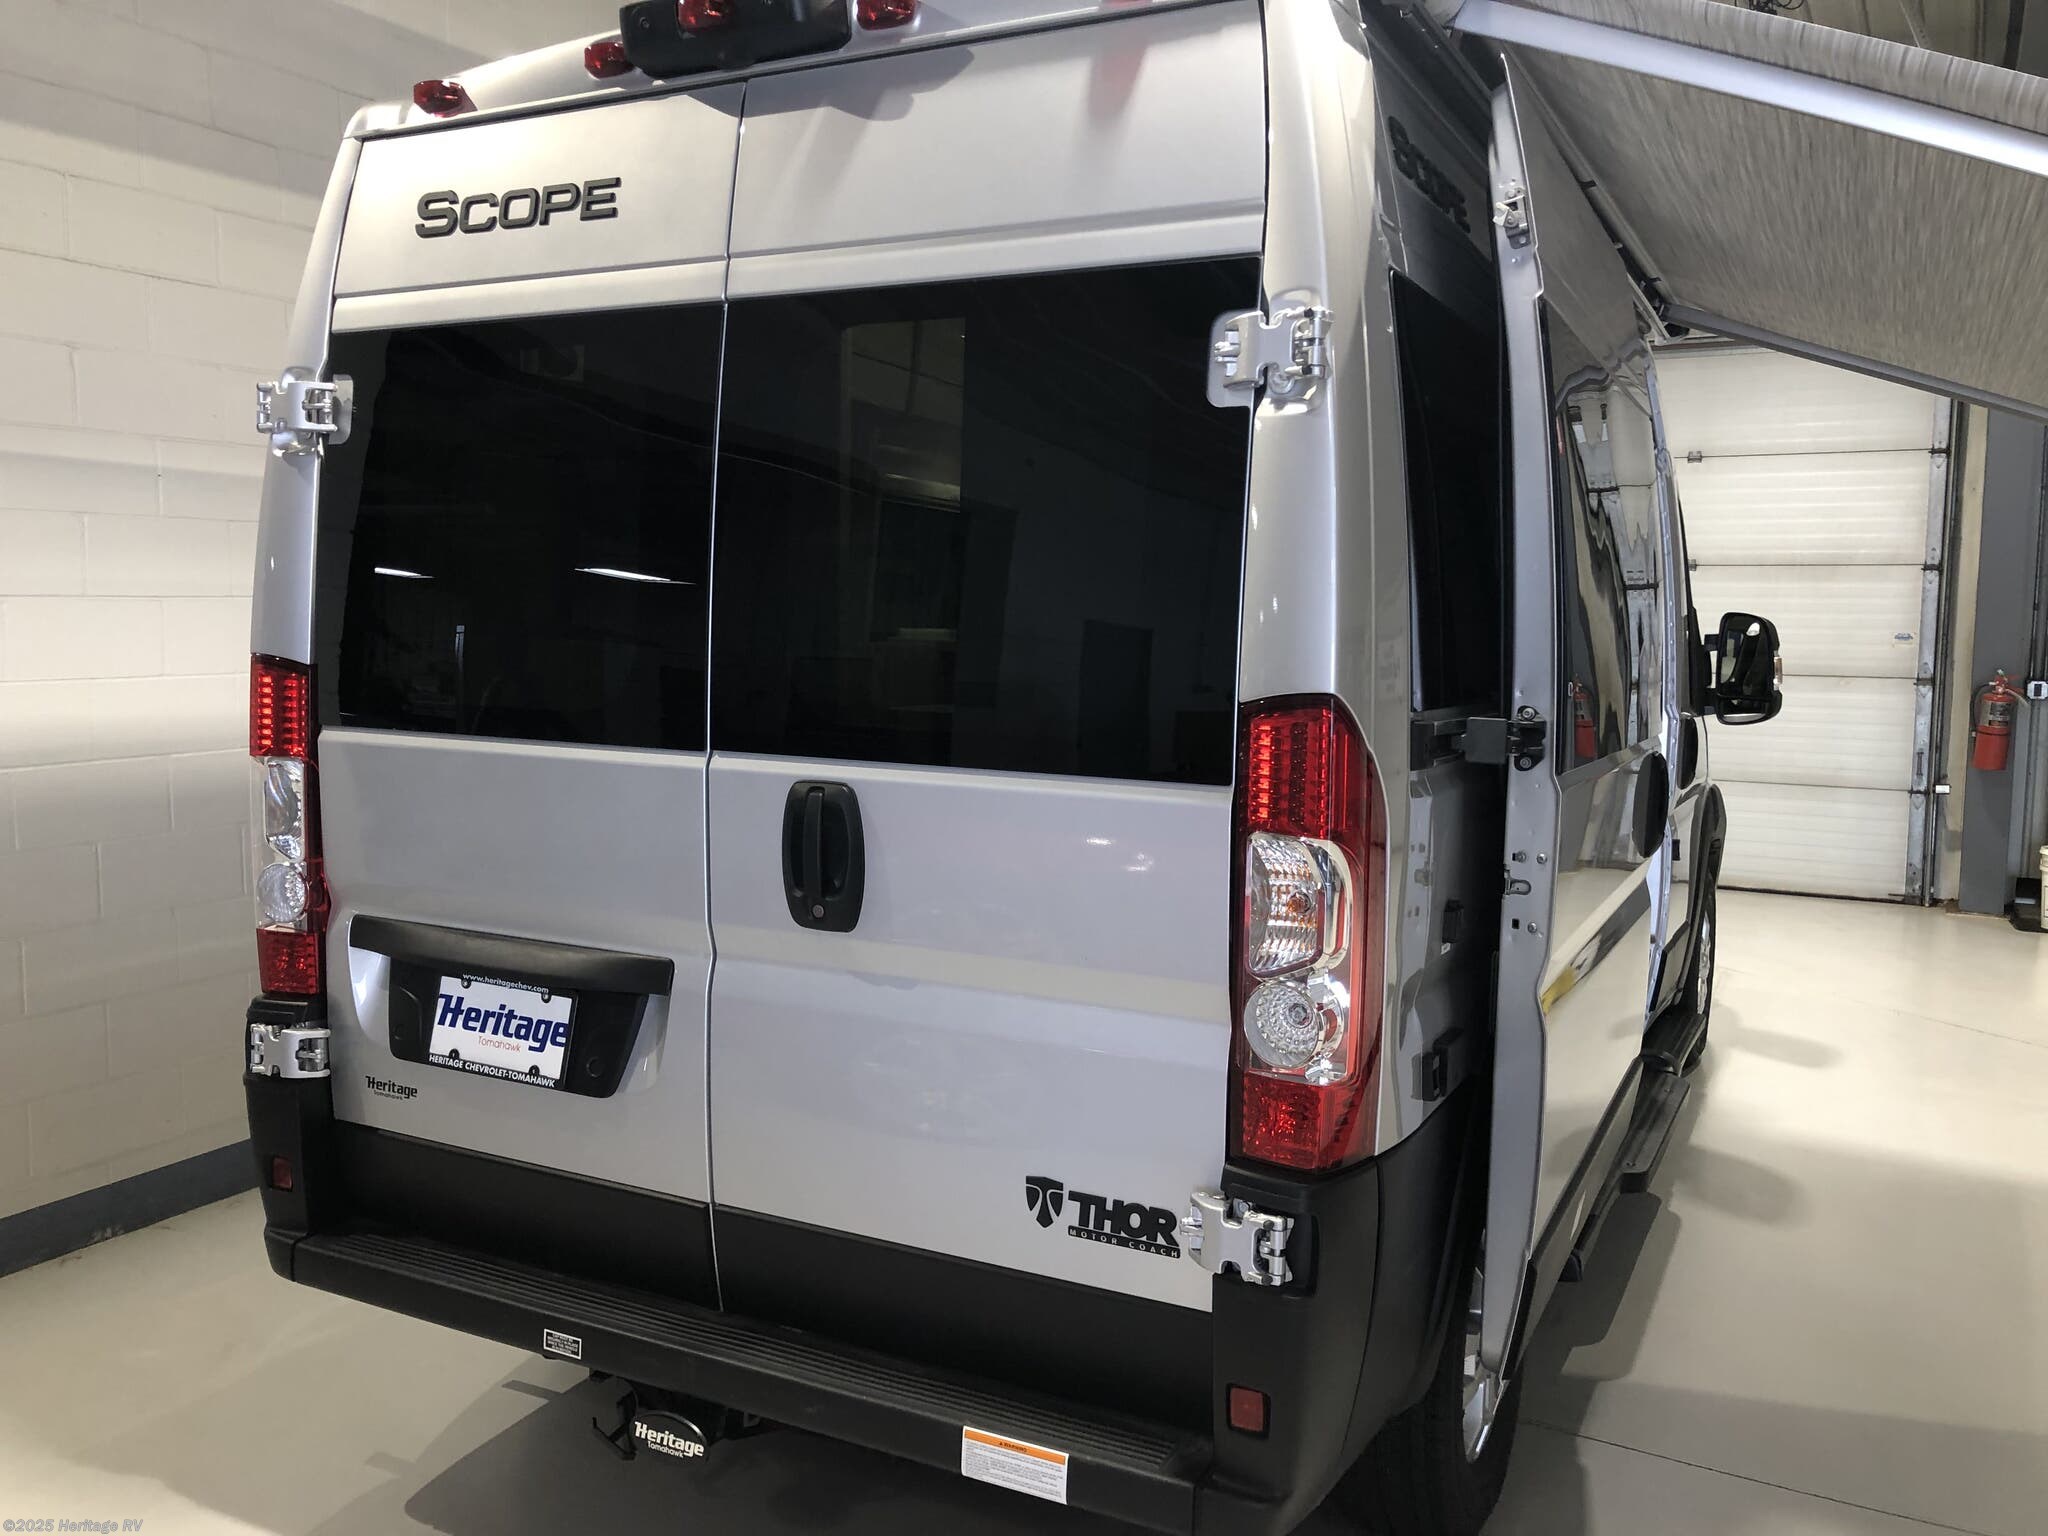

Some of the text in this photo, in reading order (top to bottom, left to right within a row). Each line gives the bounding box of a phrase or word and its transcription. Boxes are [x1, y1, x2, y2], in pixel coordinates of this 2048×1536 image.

[415, 177, 622, 239] SCOPE
[462, 973, 549, 994] www.heritagechev.com
[438, 993, 570, 1053] Heritage
[478, 1035, 521, 1053] Tomahawk
[365, 1075, 418, 1100] Heritage
[429, 1054, 556, 1088] HERITAGE CHEVROLET-TOMAHAWK
[1068, 1190, 1180, 1247] THOR
[1069, 1228, 1178, 1258] MOTOR COACH
[634, 1421, 705, 1458] Heritage
